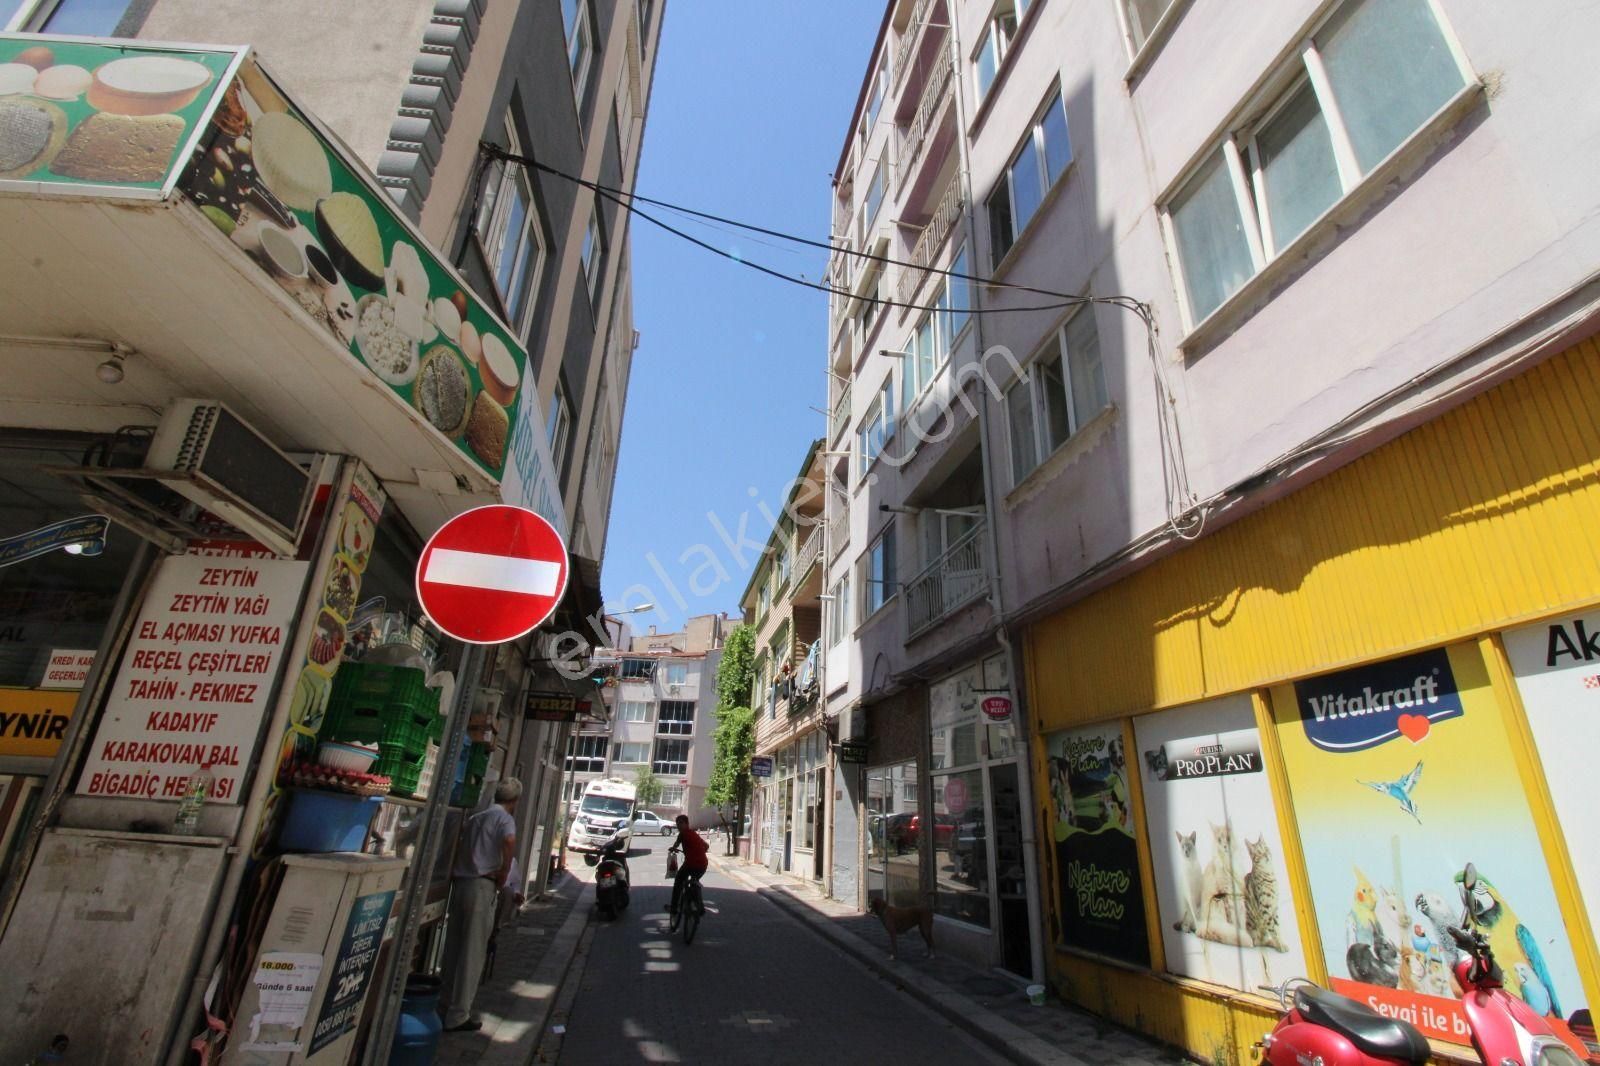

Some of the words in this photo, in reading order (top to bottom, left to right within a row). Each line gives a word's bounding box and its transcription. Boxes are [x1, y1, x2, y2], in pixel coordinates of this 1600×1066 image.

[199, 566, 258, 587] ZEYTİN
[169, 592, 230, 614] ZEYTİN
[232, 595, 270, 616] YAĞI
[138, 622, 159, 640] EL
[162, 623, 225, 645] AÇMASI
[229, 625, 281, 645] YUFKA
[131, 650, 182, 674] REÇEL
[187, 649, 272, 677] ÇEŞİTLERİ
[128, 679, 177, 700] TAHİN
[189, 683, 258, 703] PEKMEZ
[1308, 674, 1439, 722] Vitakraft
[145, 711, 219, 733] KADAYIF
[100, 741, 205, 765] KARAKOVAN
[206, 746, 240, 766] BAL
[1062, 735, 1104, 758] Nature
[1070, 756, 1101, 773] Plan
[88, 768, 161, 801] BİGADİÇ
[1068, 860, 1130, 894] Nature
[1077, 888, 1124, 920] Plan
[1423, 1005, 1449, 1032] ile
